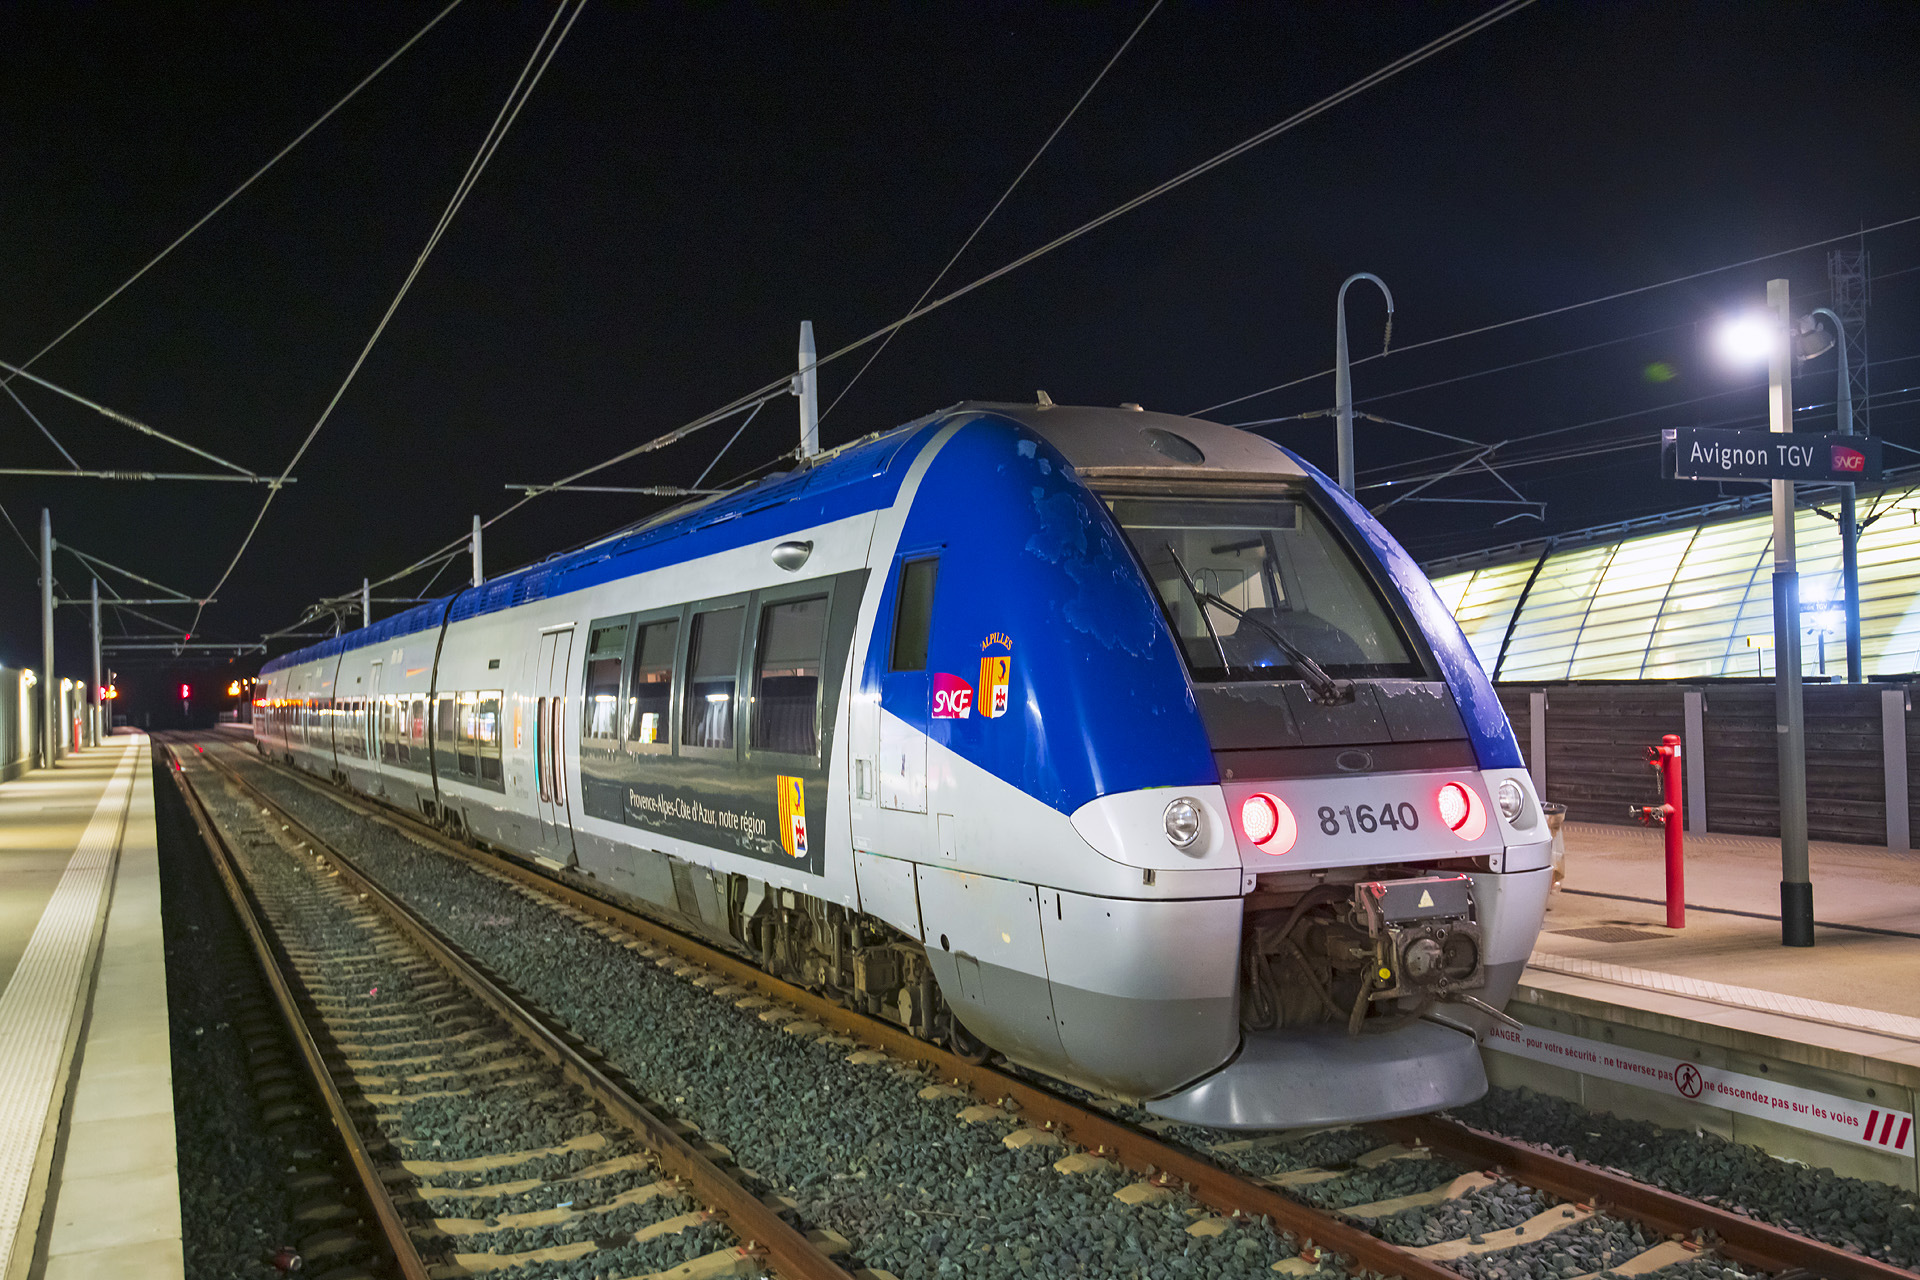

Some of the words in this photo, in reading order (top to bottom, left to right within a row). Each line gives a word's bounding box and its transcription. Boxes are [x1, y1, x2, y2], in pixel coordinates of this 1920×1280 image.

[1690, 441, 1768, 470] Avignon
[1776, 444, 1814, 467] TGV
[1834, 456, 1862, 470] SNCF
[981, 632, 1013, 651] ALPILLES
[934, 689, 971, 712] SNCF
[629, 788, 692, 820] Provence-Alpes-Côte
[718, 812, 738, 830] notre
[740, 810, 766, 839] région
[1317, 801, 1419, 836] 81640
[1490, 1027, 1521, 1043] DANGER
[1526, 1038, 1543, 1049] pour
[1544, 1042, 1563, 1055] votre
[1564, 1046, 1597, 1063] sécurité
[1604, 1057, 1614, 1067] ne
[1616, 1058, 1656, 1077] traversez
[1657, 1069, 1673, 1081] pas
[1704, 1081, 1715, 1092] ne
[1717, 1082, 1769, 1105] descendez
[1771, 1096, 1789, 1110] pas
[1792, 1103, 1809, 1115] sur
[1811, 1104, 1827, 1119] les
[1829, 1109, 1859, 1127] voies
